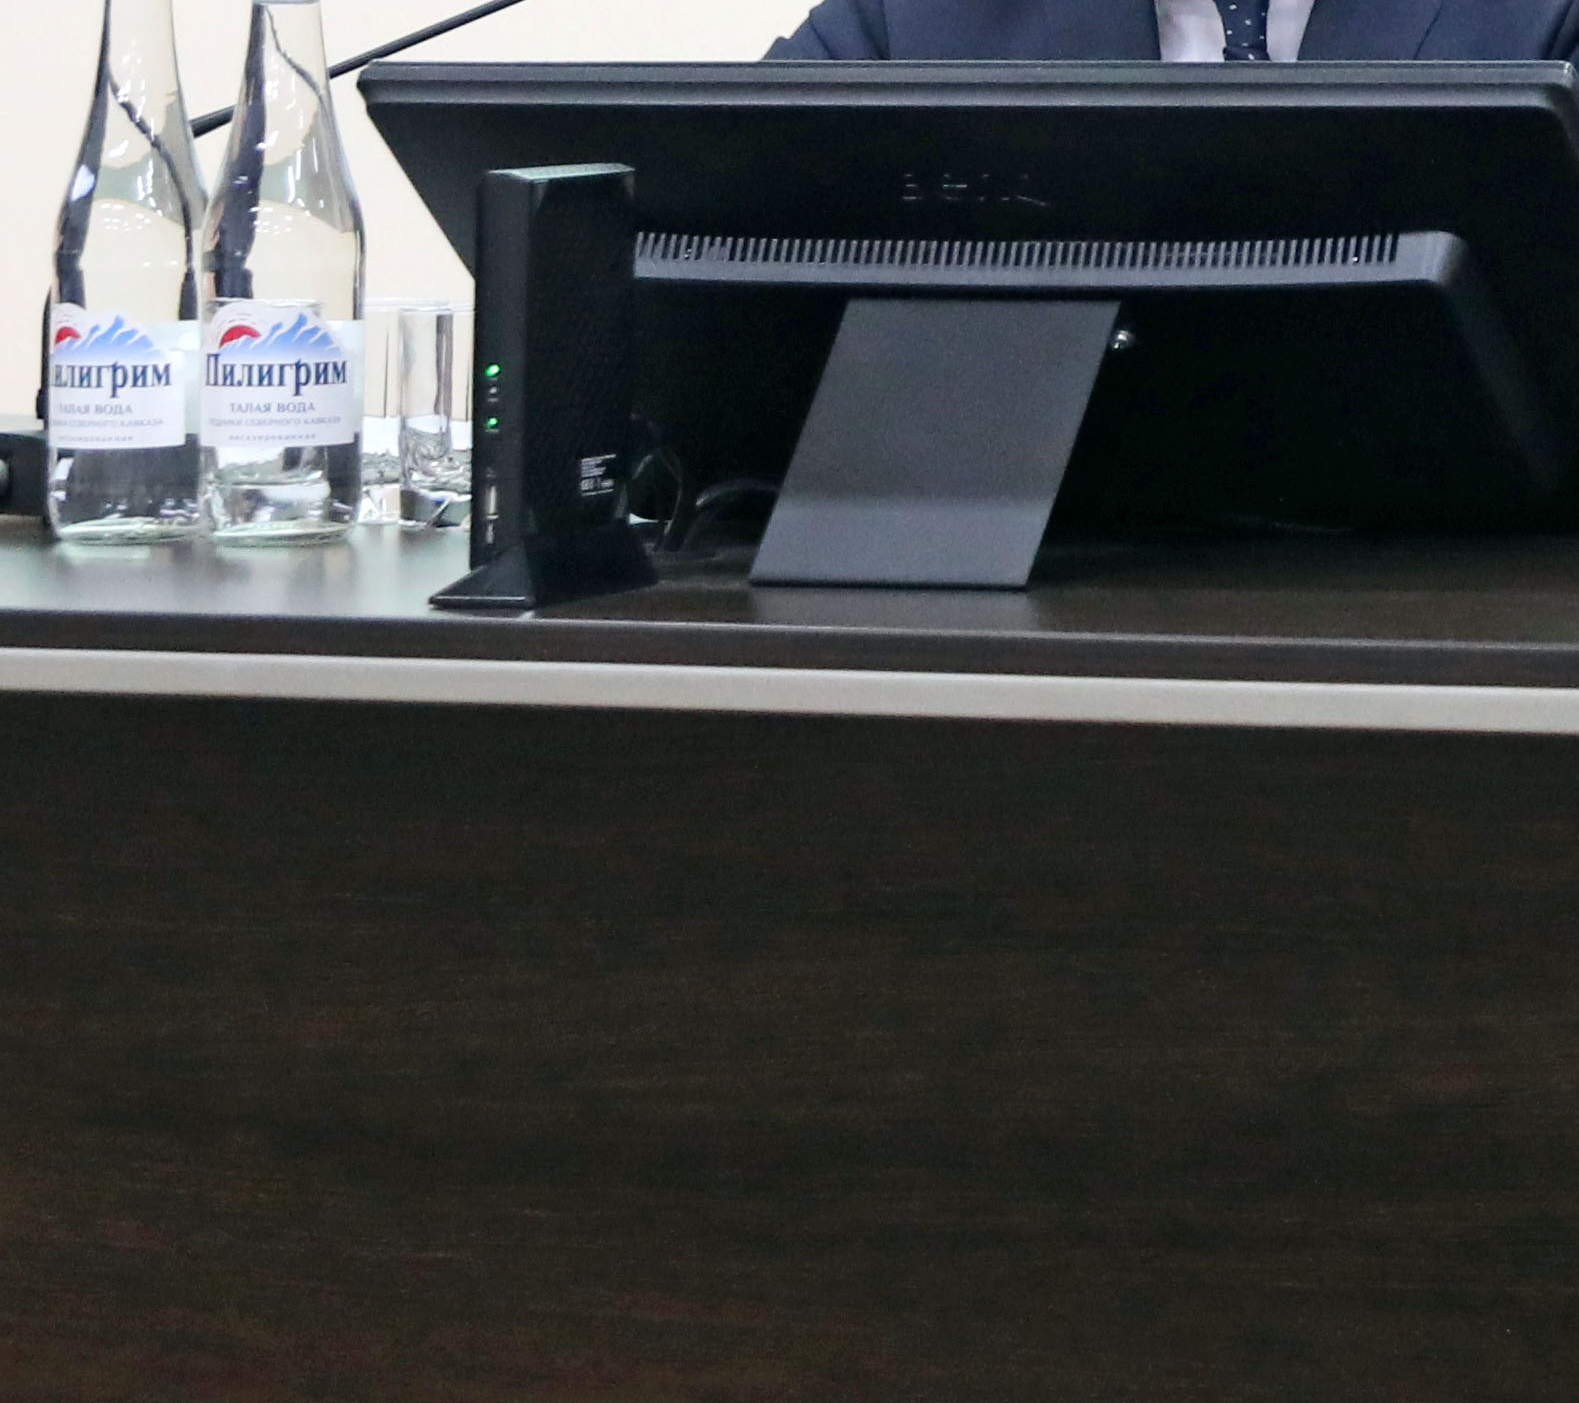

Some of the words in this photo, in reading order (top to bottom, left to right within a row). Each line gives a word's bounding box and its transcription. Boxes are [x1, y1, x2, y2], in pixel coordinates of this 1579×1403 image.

[51, 361, 172, 398] илигрим
[205, 353, 348, 397] Пилигрим
[95, 403, 133, 415] ВОДА
[229, 402, 272, 413] ТАЛАЯ
[276, 402, 316, 414] ВОДА
